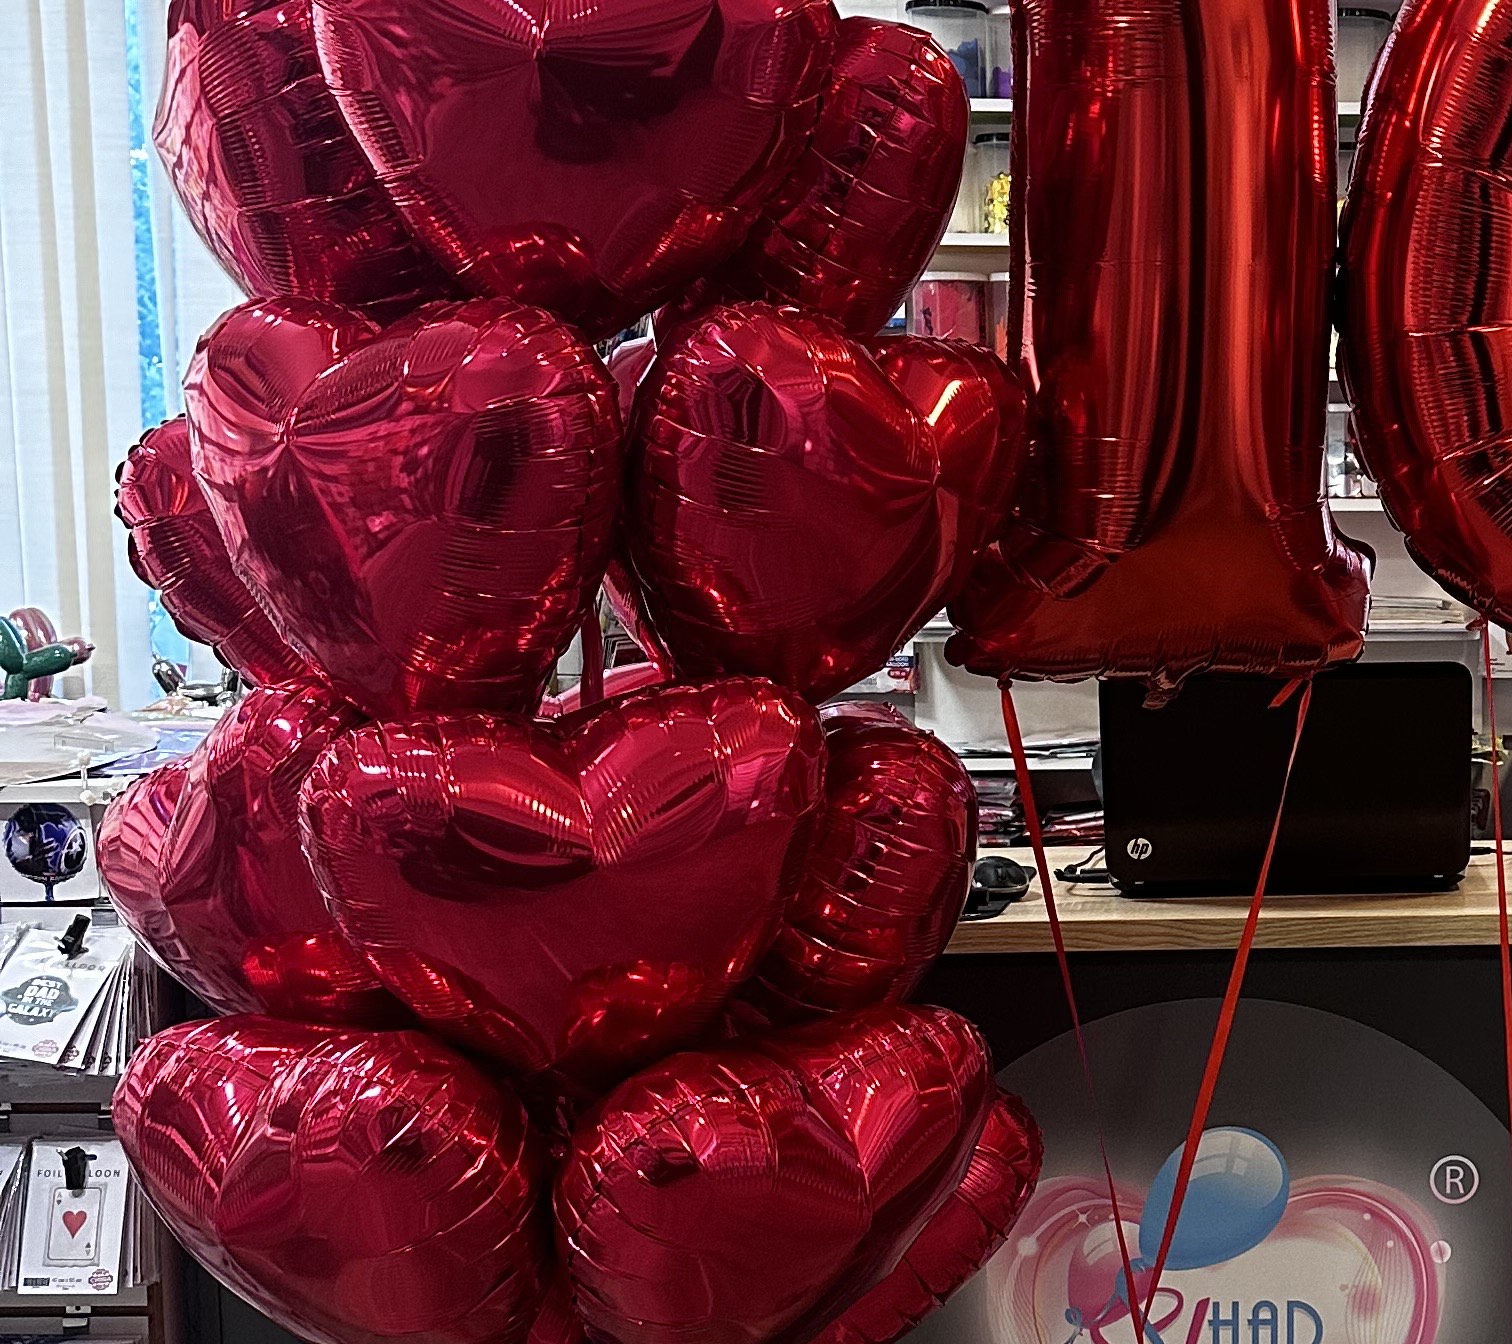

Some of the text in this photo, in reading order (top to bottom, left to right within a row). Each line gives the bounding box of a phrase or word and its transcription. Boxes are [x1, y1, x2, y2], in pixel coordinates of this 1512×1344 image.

[1127, 838, 1153, 860] hp
[23, 984, 61, 1000] DAD
[37, 1169, 63, 1178] FOIL
